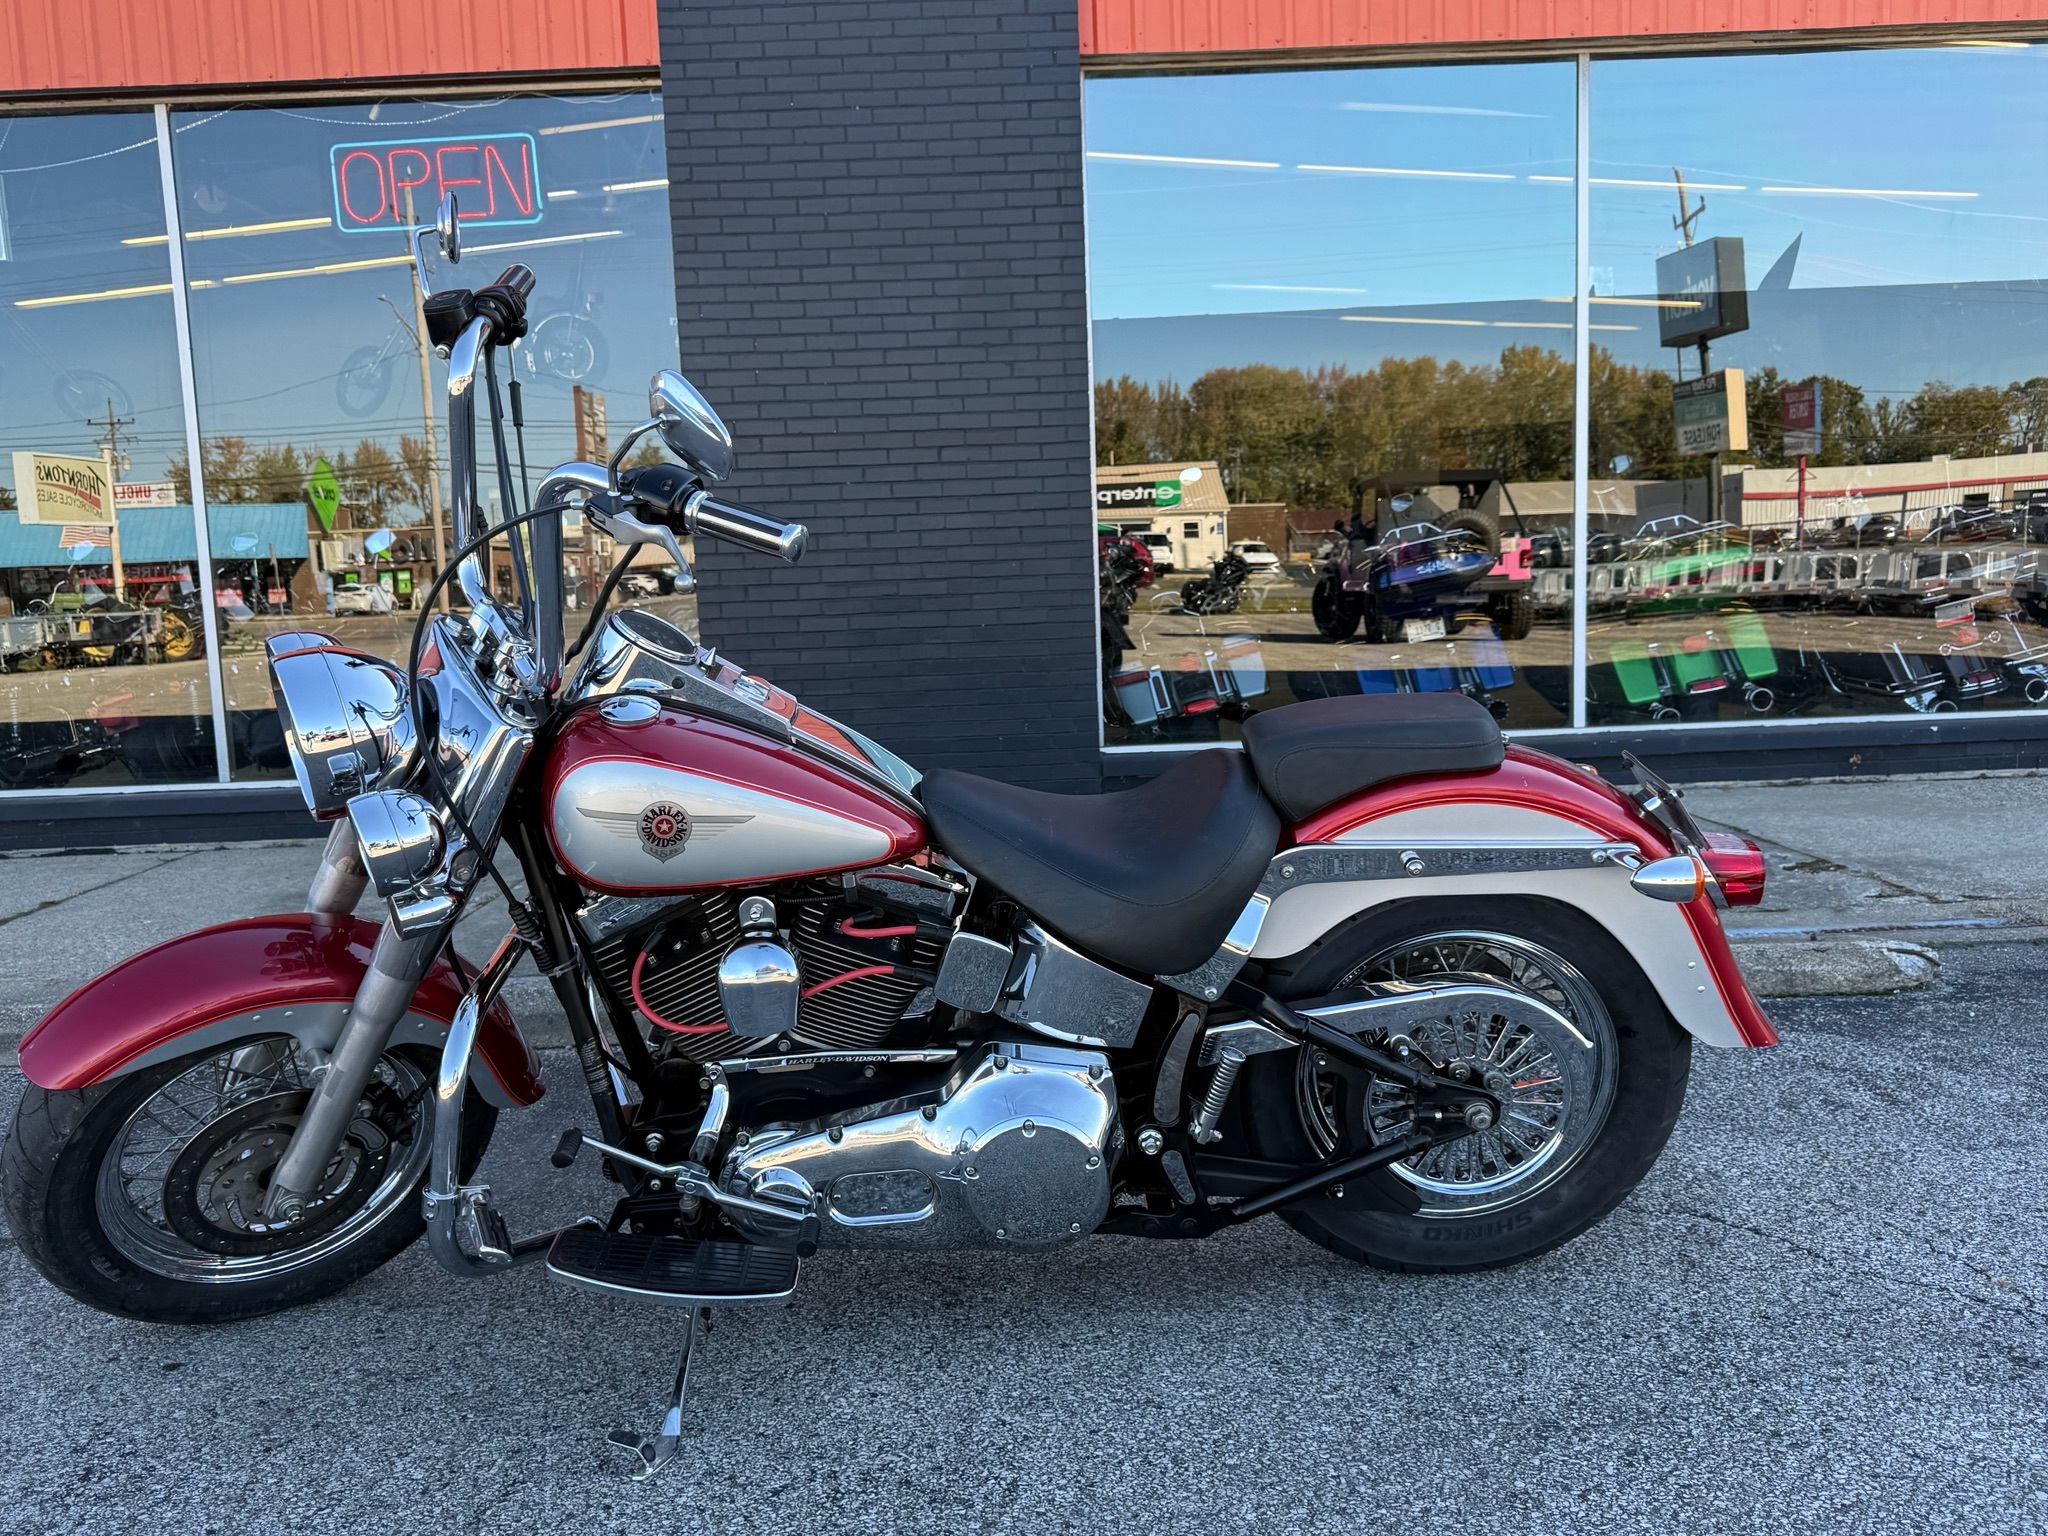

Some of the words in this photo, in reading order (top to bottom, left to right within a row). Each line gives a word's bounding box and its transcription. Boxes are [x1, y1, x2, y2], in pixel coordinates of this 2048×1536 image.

[341, 144, 532, 223] OPEN
[642, 805, 688, 827] HARLEY
[641, 826, 688, 848] DAVIDSON
[788, 1055, 889, 1065] HARLEY-DAVIDSON
[1422, 1210, 1533, 1241] SHINKO
